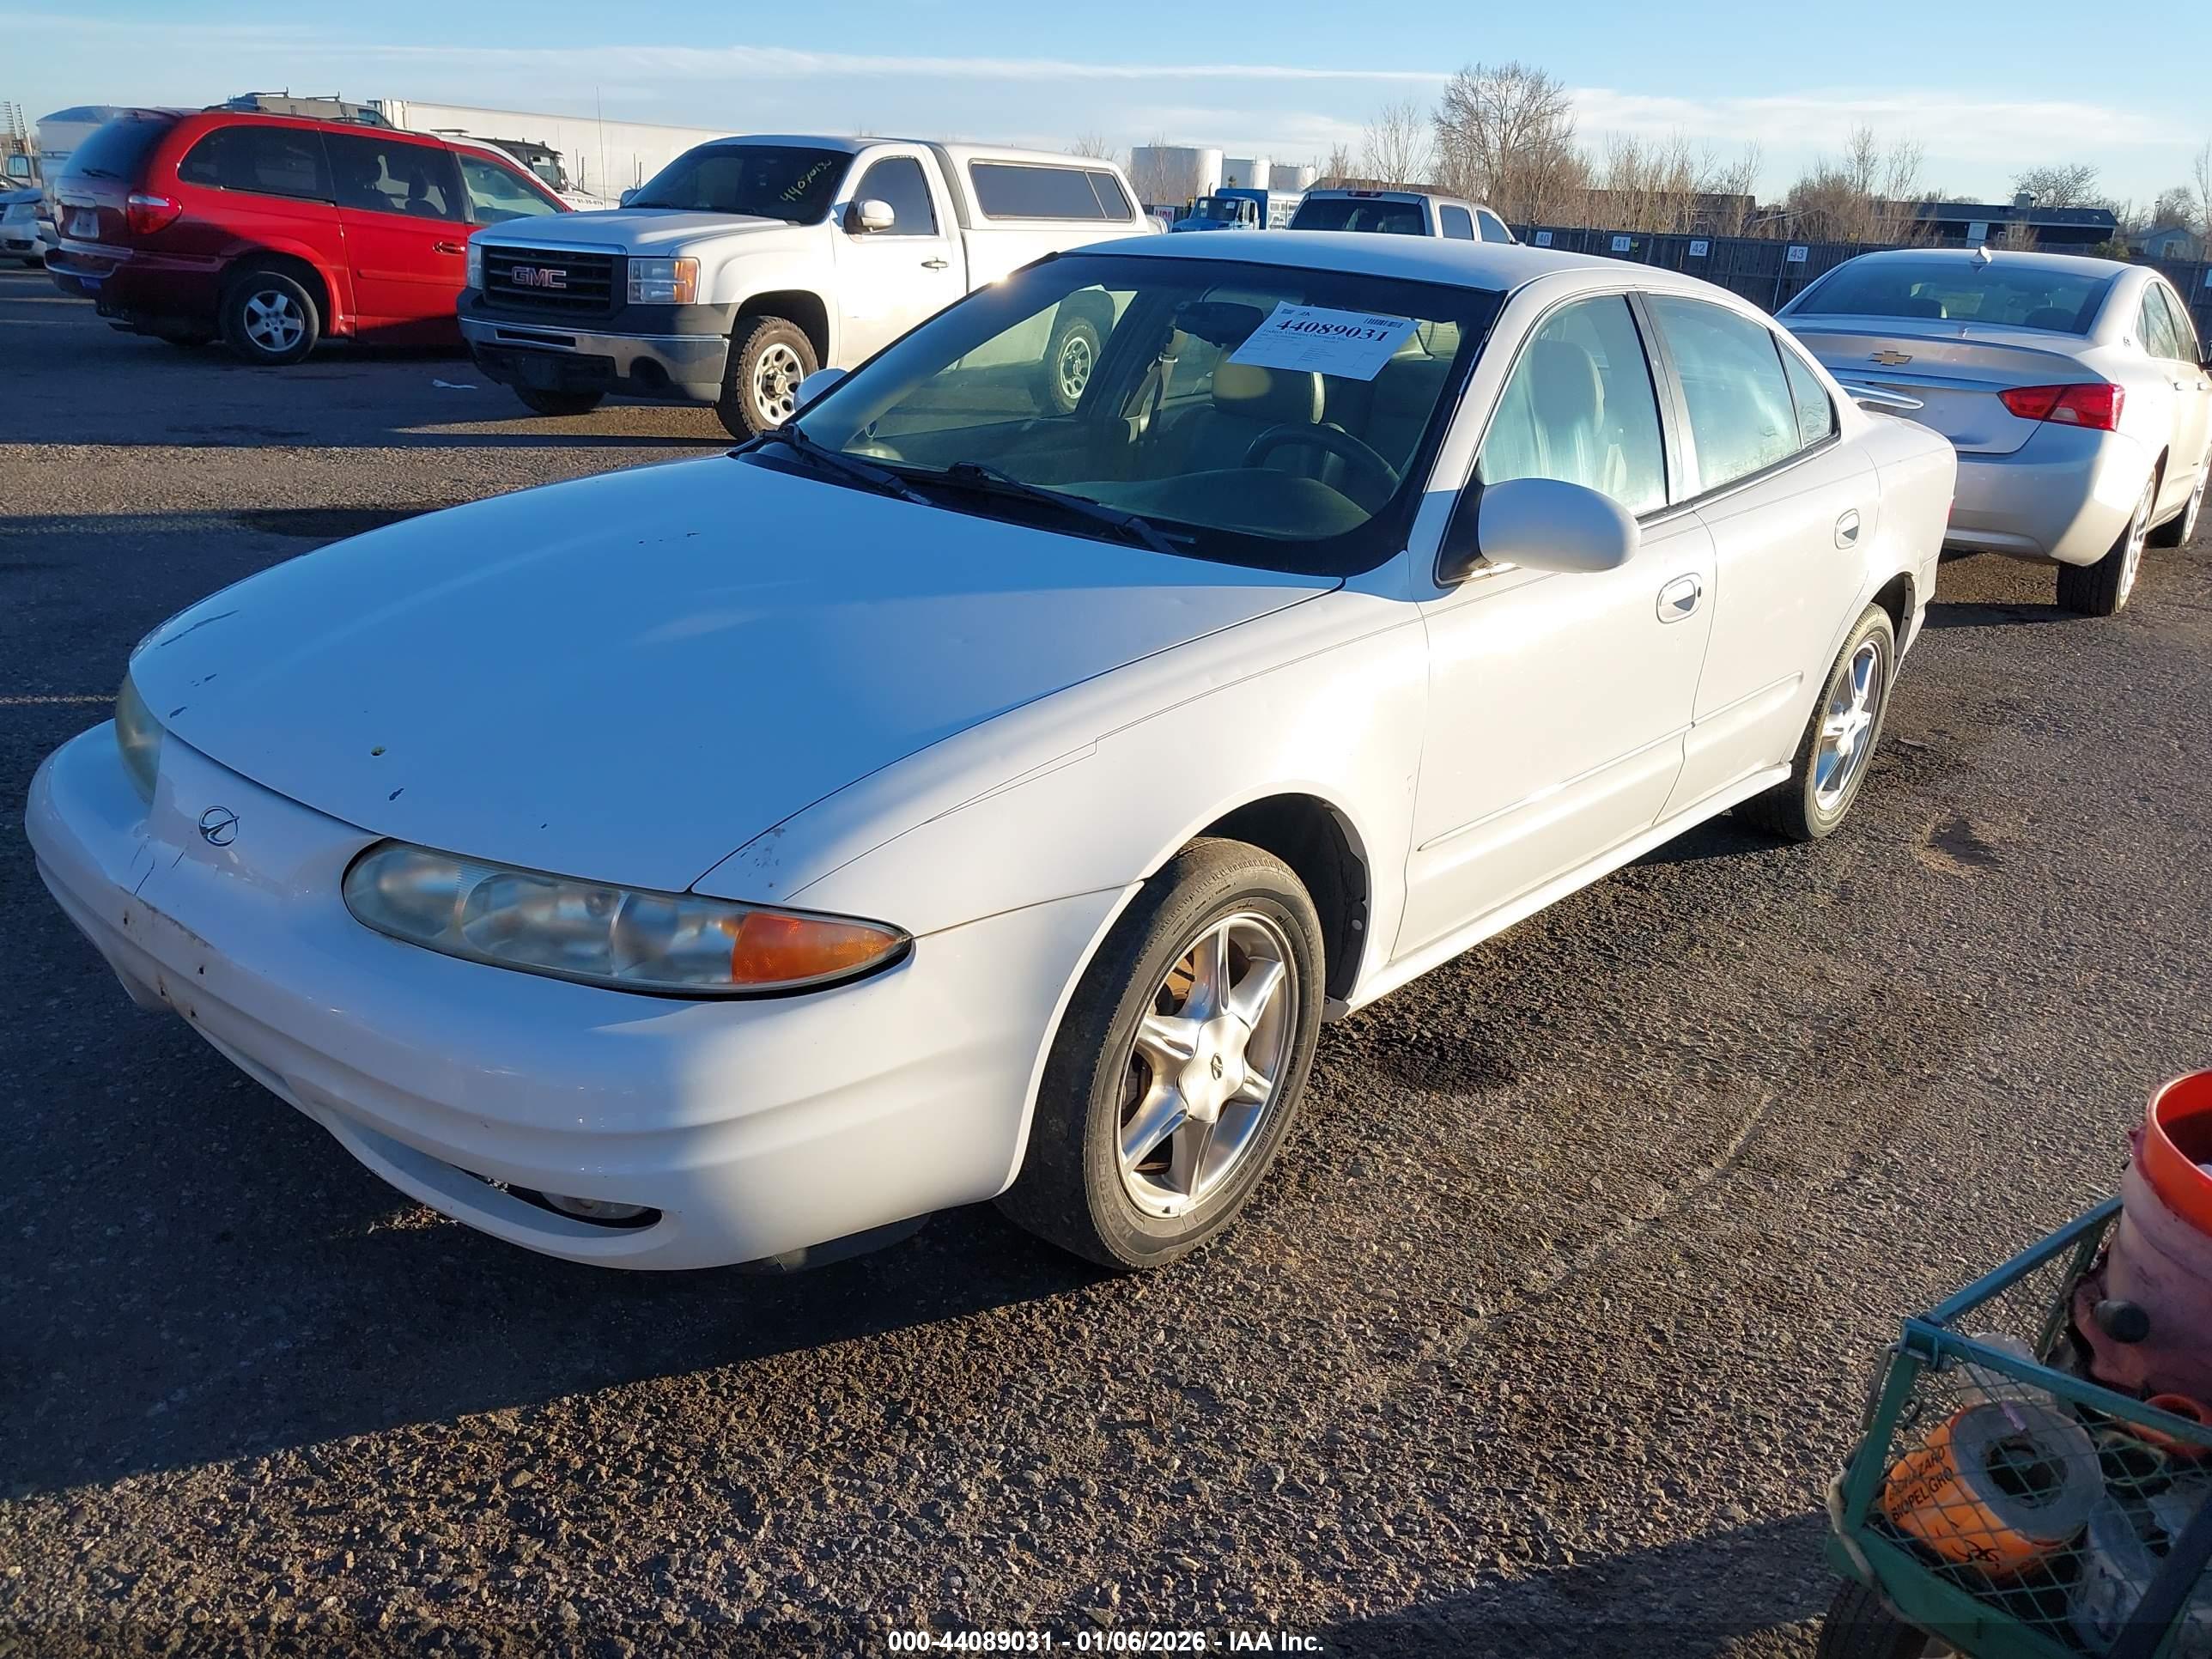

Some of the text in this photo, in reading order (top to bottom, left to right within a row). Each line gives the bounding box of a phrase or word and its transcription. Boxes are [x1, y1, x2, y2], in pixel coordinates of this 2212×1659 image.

[1538, 233, 1549, 242] 40
[1614, 239, 1626, 247] 41
[1692, 243, 1705, 254] 42
[1790, 248, 1804, 259] 43
[511, 265, 567, 289] GMC
[1276, 319, 1389, 343] 44089031
